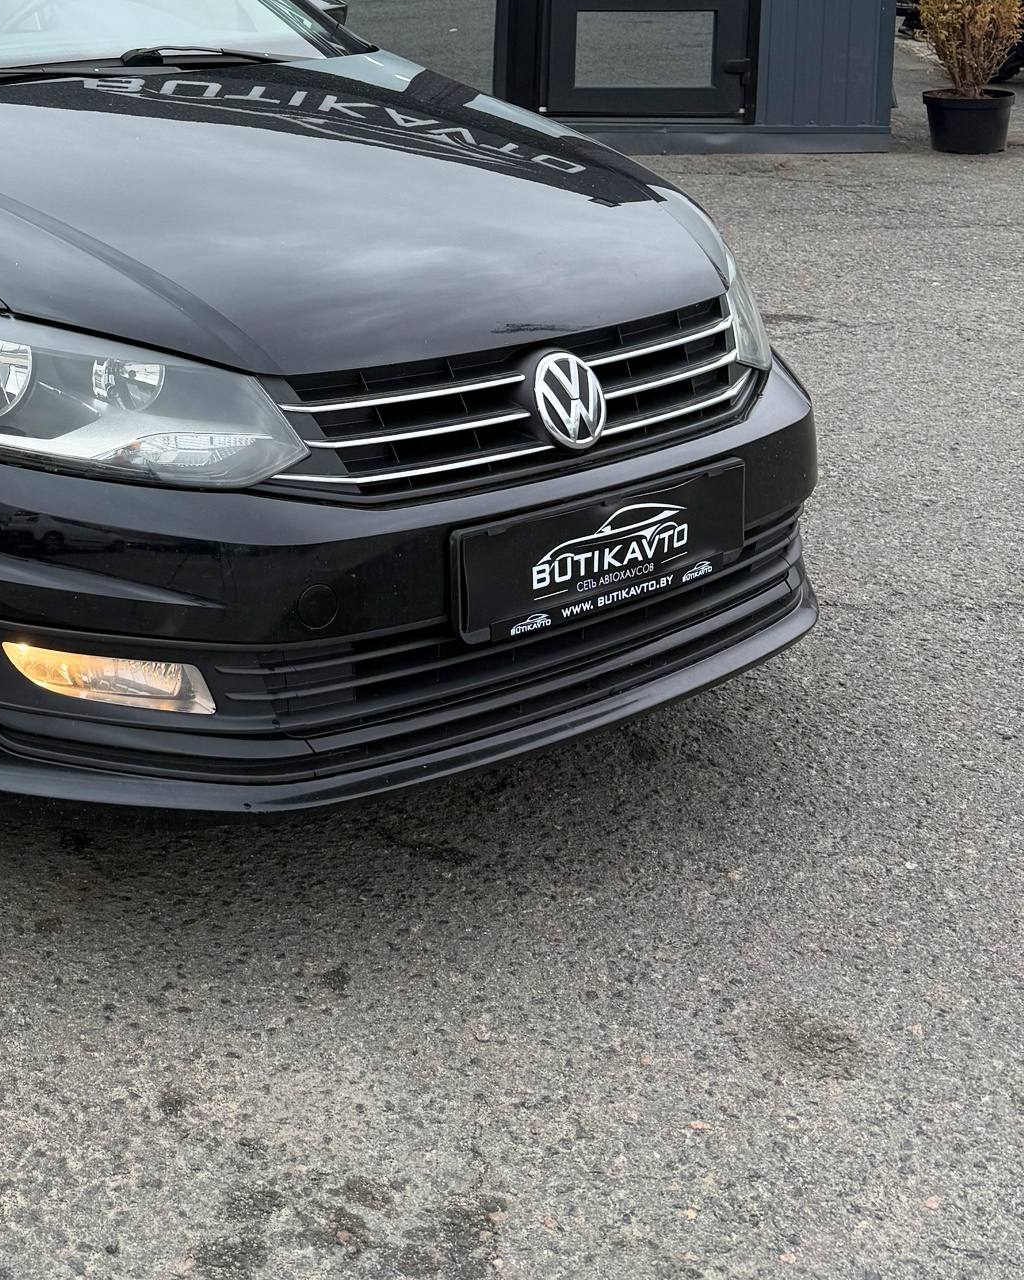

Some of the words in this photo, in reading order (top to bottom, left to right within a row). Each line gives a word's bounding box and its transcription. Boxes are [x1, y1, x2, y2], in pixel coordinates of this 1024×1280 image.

[532, 523, 689, 590] BUTIKAVTO
[576, 578, 597, 592] СЕТЬ
[598, 563, 654, 587] АВТОХАУСОВ
[682, 565, 713, 582] BUTIKAVTO
[561, 600, 594, 618] WWW.
[597, 574, 674, 608] BUTIKAVTO.BY
[510, 618, 552, 636] BUTIKAVTO
